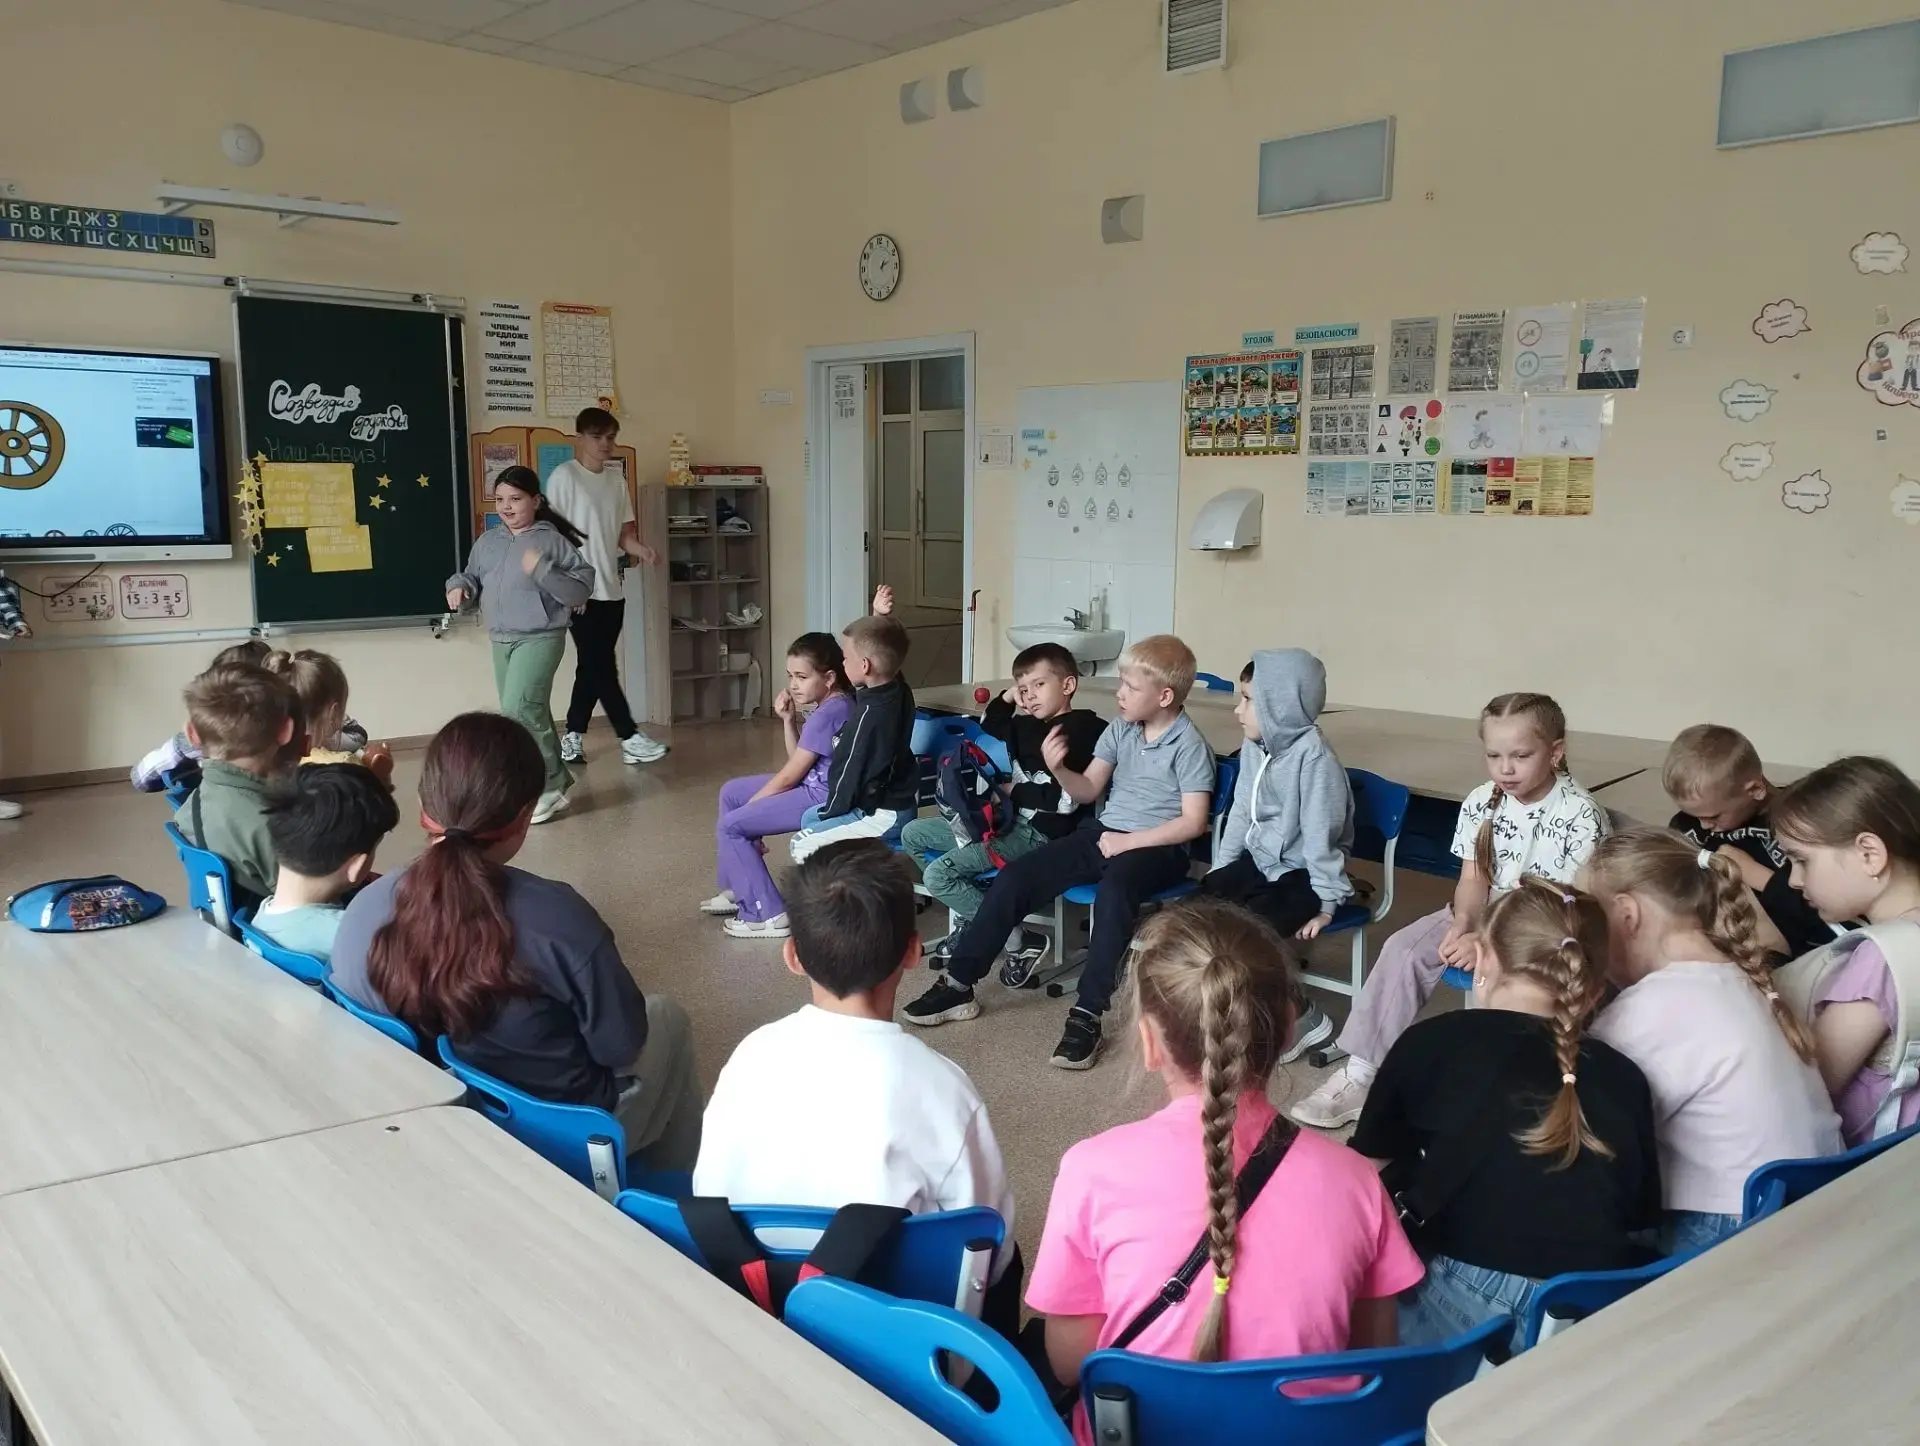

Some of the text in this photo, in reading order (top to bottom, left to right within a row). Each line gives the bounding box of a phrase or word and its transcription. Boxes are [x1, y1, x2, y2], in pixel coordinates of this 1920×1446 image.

[491, 323, 519, 331] ЧЛЕНЫ
[486, 330, 529, 340] ПРЕДЛОЖЕ
[1244, 327, 1358, 345] УГОЛОК БЕЗОПАСНОСТИ
[489, 365, 527, 374] СКАЗУЕМОЕ
[487, 378, 534, 387] ОПРЕДЕЛЕНИЕ
[271, 383, 355, 422] Созвездие
[488, 404, 532, 412] ДОПОЛНЕНИЕ
[351, 405, 408, 440] дружбы
